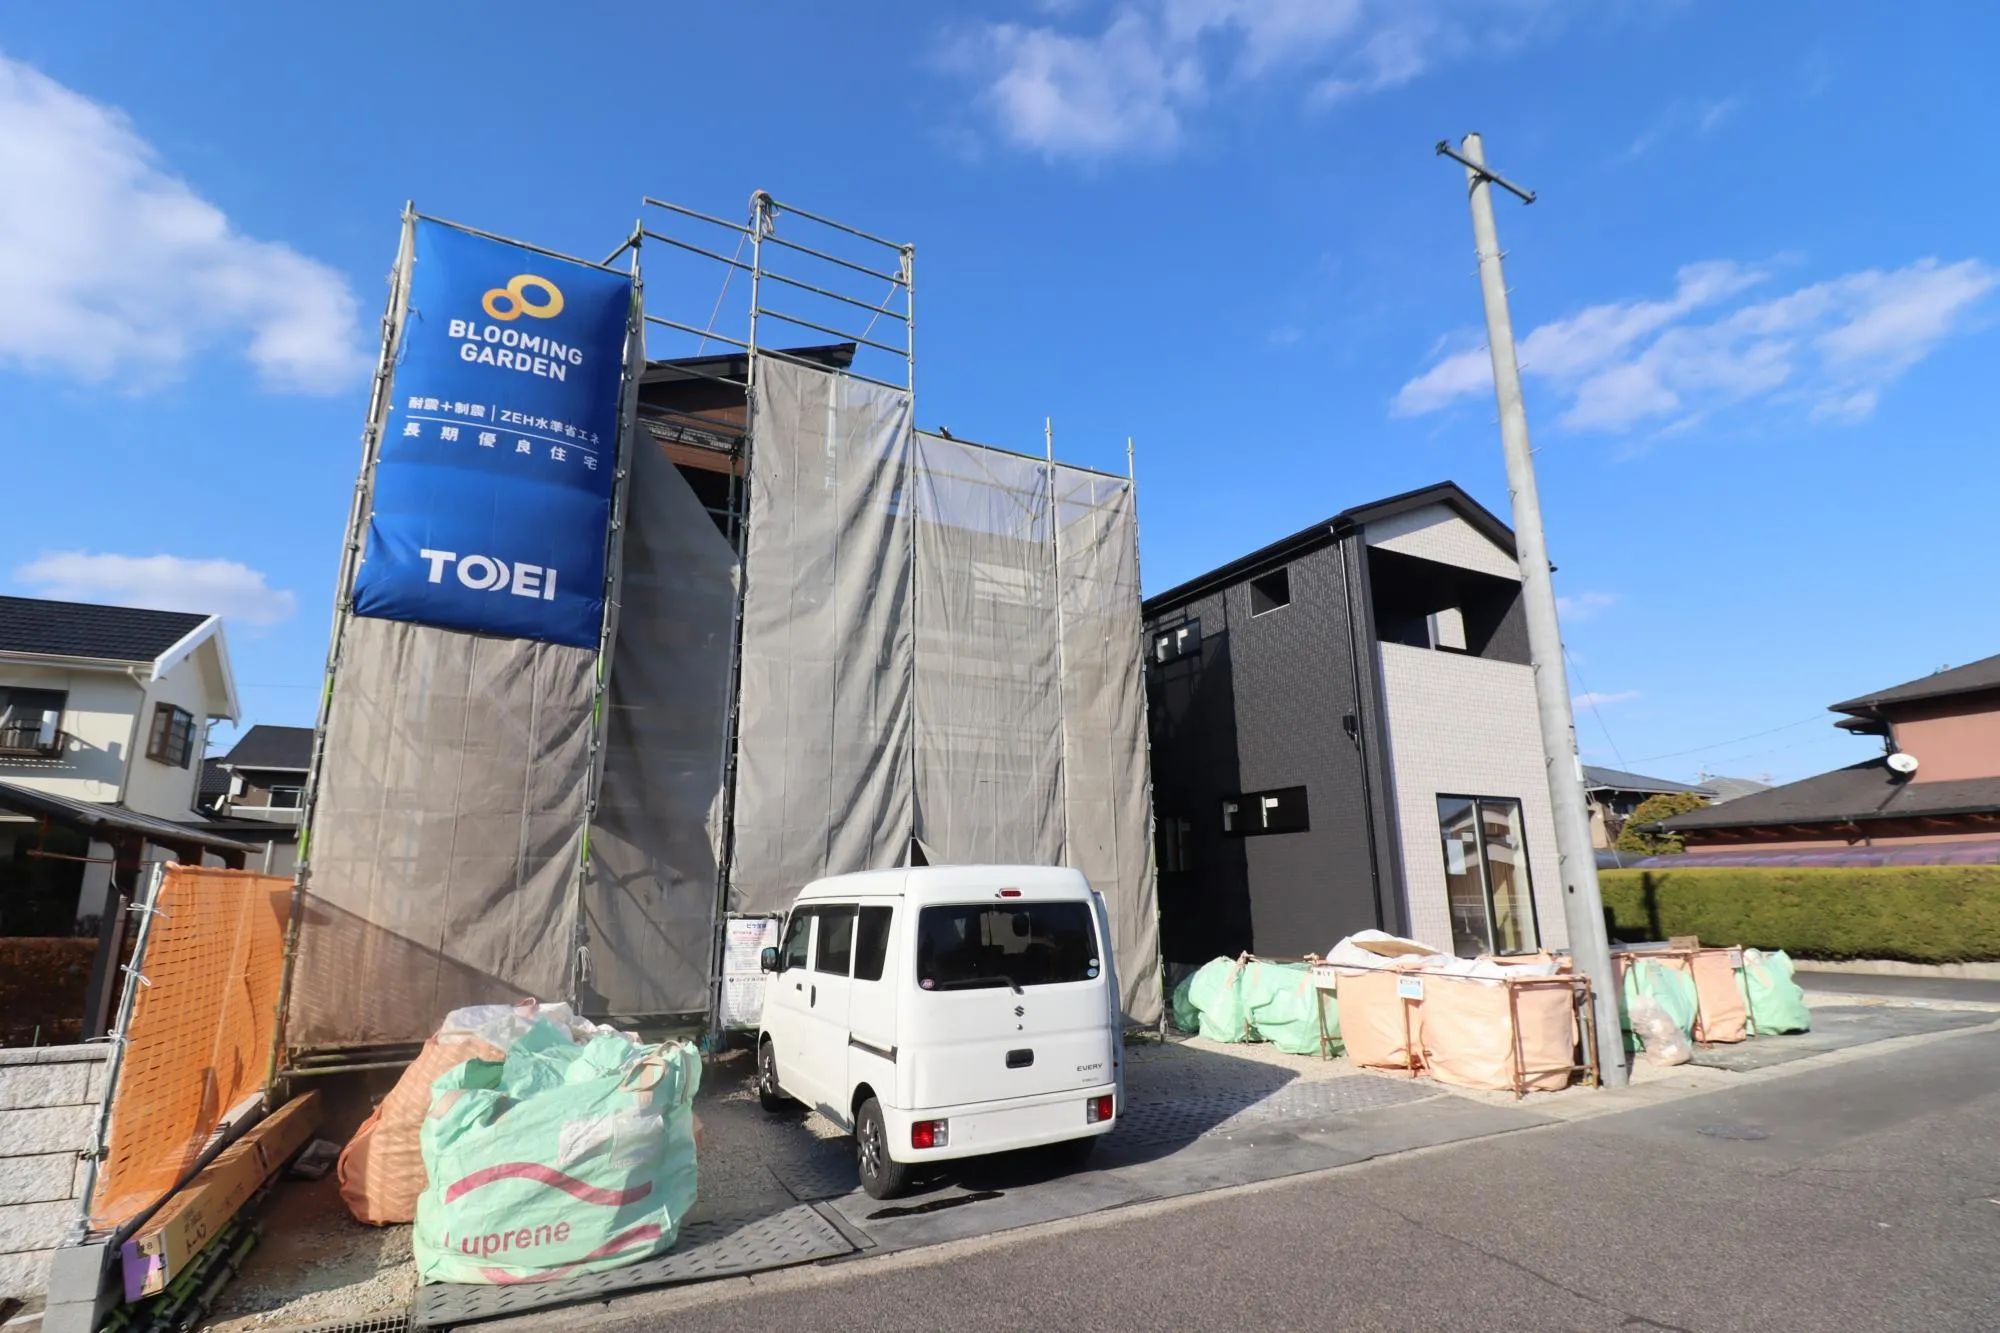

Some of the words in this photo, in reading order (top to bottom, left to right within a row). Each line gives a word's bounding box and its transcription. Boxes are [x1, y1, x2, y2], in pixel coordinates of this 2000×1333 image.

[448, 319, 583, 366] BLOOMING
[460, 343, 567, 382] GARDEN
[403, 422, 598, 471] 長期優良住宅
[500, 409, 600, 446] ZEH水準省エネ
[1076, 1063, 1103, 1072] EVERY
